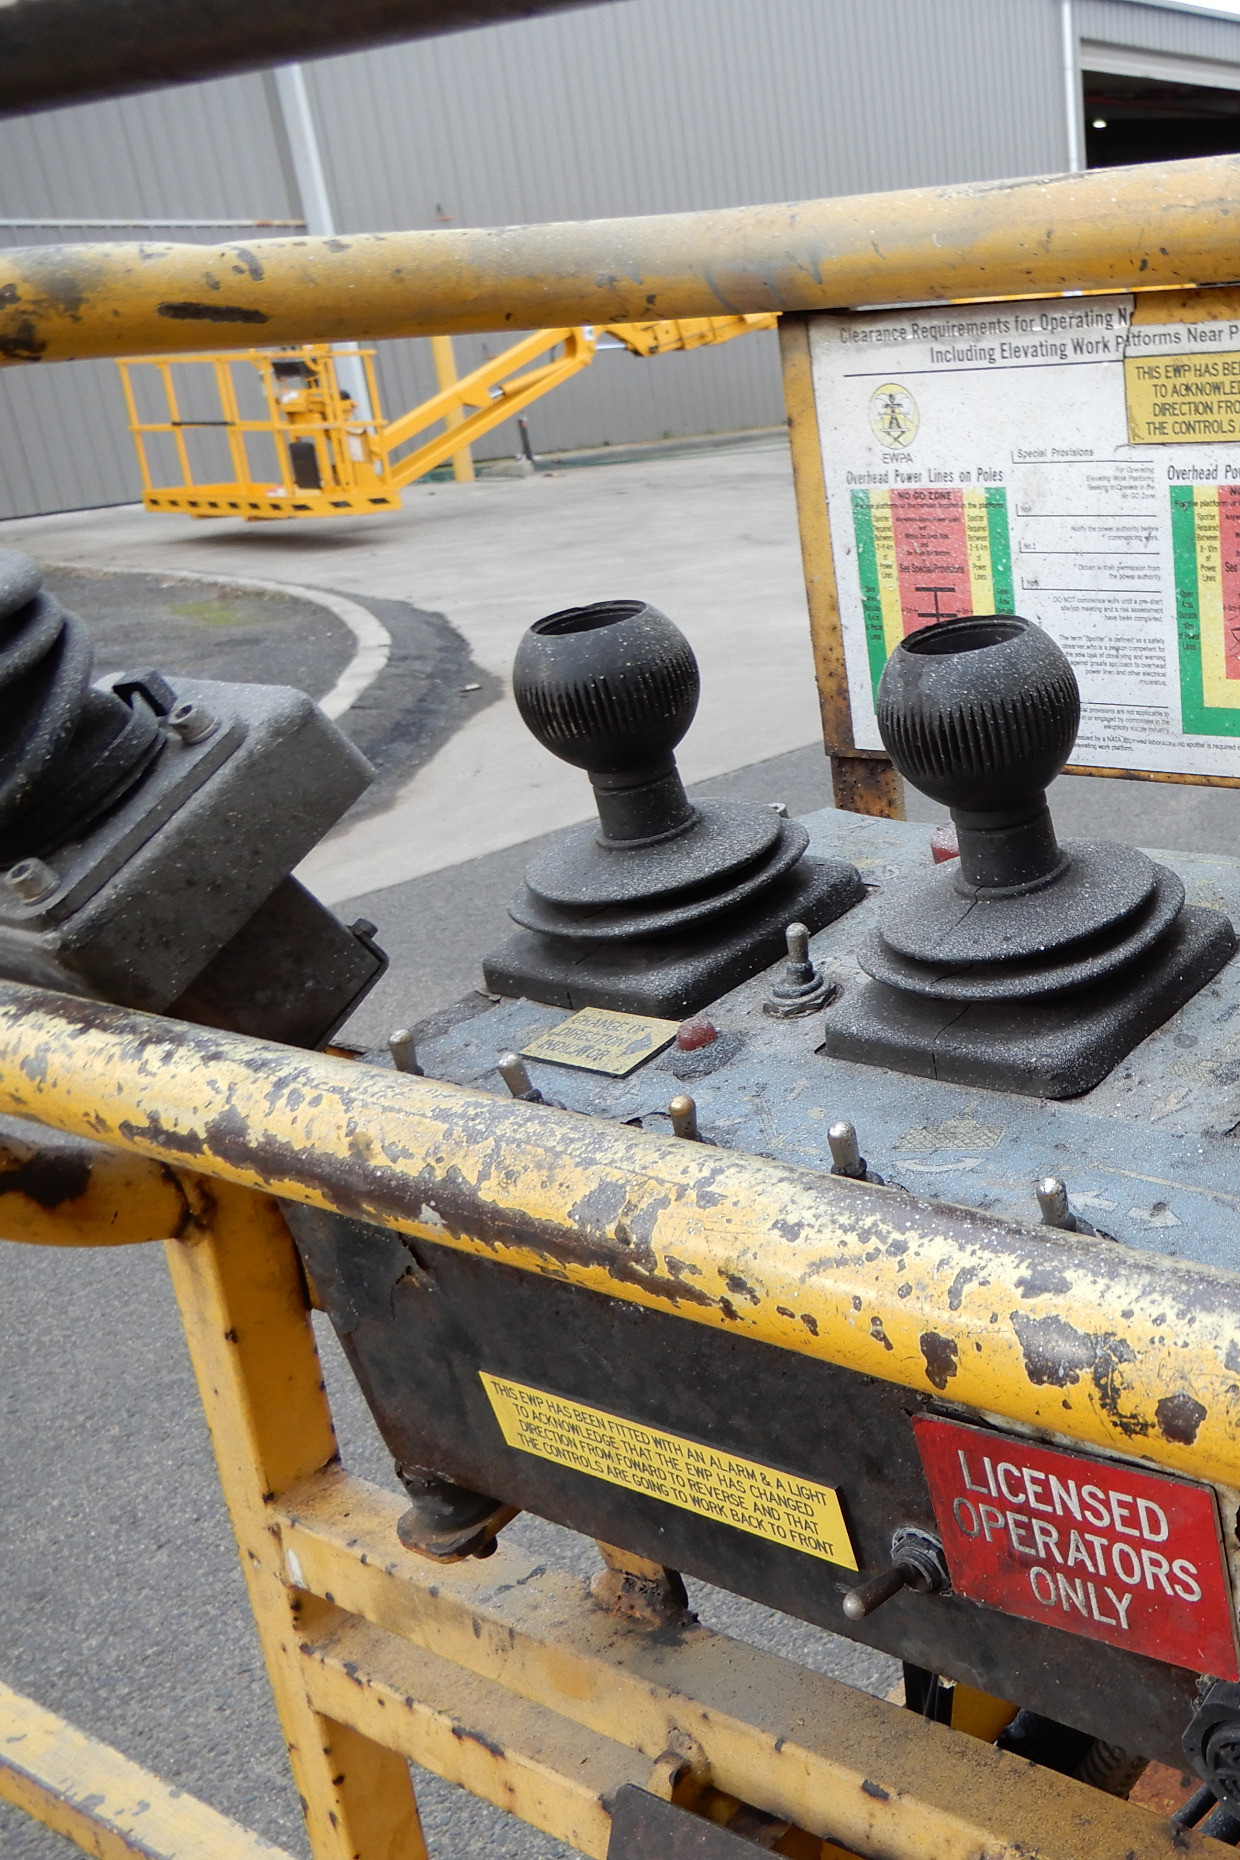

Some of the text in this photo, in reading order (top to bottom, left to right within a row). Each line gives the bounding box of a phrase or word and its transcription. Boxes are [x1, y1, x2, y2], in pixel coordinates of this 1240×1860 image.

[840, 325, 907, 344] Clearance
[912, 317, 1010, 341] Requirements
[1015, 314, 1034, 332] for
[1041, 311, 1113, 332] Operating
[930, 344, 996, 363] Including
[1000, 340, 1067, 360] Elevating
[1072, 337, 1110, 355] Work
[1188, 327, 1223, 343] Near
[1135, 366, 1162, 380] THIS
[1165, 364, 1191, 379] EWP
[1194, 363, 1219, 377] HAS
[1153, 384, 1168, 398] TO
[1153, 401, 1213, 417] DIRECTION
[1146, 421, 1168, 435] THE
[1172, 419, 1236, 435] CONTROLS
[882, 453, 914, 464] EWPA
[1017, 448, 1094, 459] Special Provisions
[846, 467, 1004, 485] Overhead Power Lines on Poles
[1167, 465, 1218, 481] Overhead
[898, 491, 952, 500] NO GO ZONE
[1225, 561, 1238, 572] See
[572, 1015, 651, 1035] CHANGE OF
[551, 1027, 631, 1048] DIRECTION
[538, 1040, 610, 1061] INDICATOR
[491, 1381, 826, 1506] THIS EWP HAS BEEN FITTED WITH AN ALARM & A LIGHT
[513, 1403, 814, 1517] TO ACKNOWLEDGE THAT THE EWP HAS CHANGED
[519, 1419, 818, 1535] DIRECTION FROM FOWARD TO REVERSE AND THAT
[517, 1432, 834, 1556] THE CONTROLS ARE GOING TO WORK BACK TO FRONT
[957, 1449, 1169, 1543] LICENSED
[953, 1497, 1202, 1602] OPERATORS
[1029, 1566, 1133, 1630] ONLY
